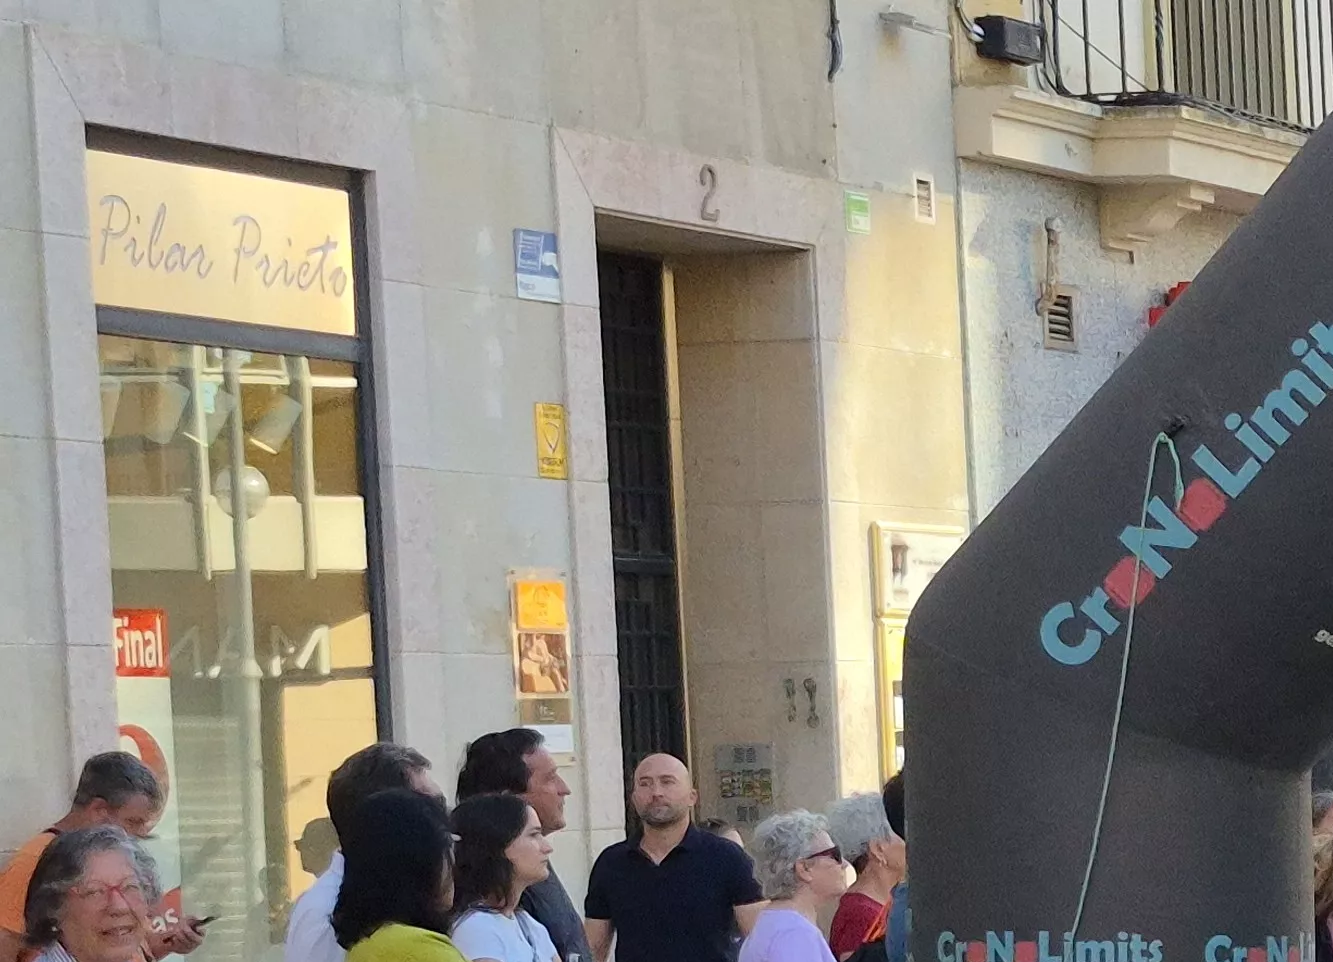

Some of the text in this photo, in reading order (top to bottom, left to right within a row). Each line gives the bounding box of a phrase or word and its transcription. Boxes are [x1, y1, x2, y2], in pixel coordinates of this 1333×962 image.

[700, 164, 720, 222] 2
[100, 194, 348, 298] Pilar Prieto
[113, 612, 164, 668] Final
